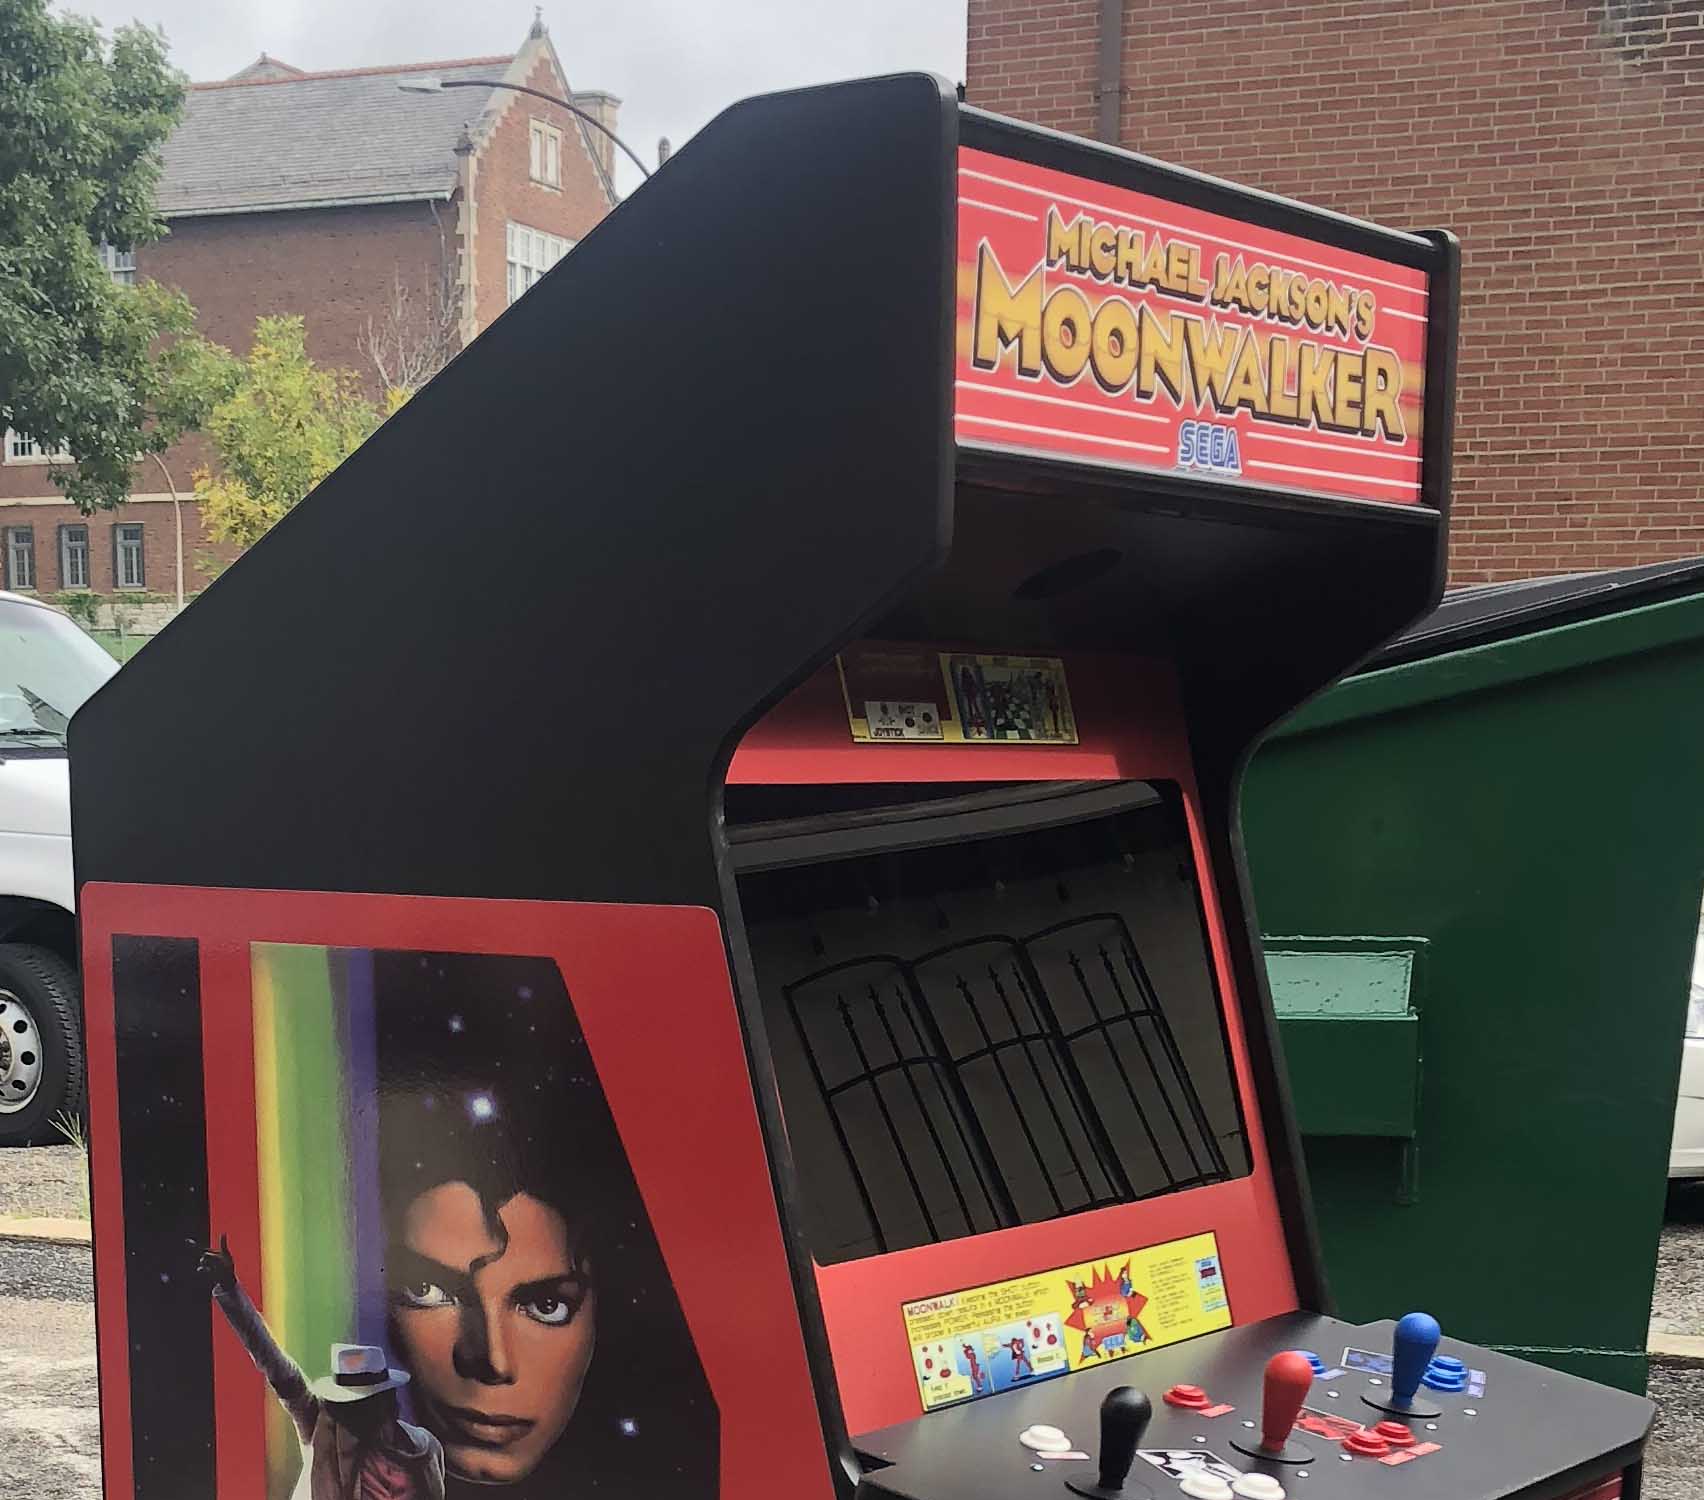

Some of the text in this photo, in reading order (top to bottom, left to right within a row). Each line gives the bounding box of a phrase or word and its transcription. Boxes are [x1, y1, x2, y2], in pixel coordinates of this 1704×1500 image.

[972, 236, 1407, 443] MOONWALKER
[1045, 204, 1376, 342] MICHAEL JACKSON'S
[1177, 421, 1242, 474] SEGA
